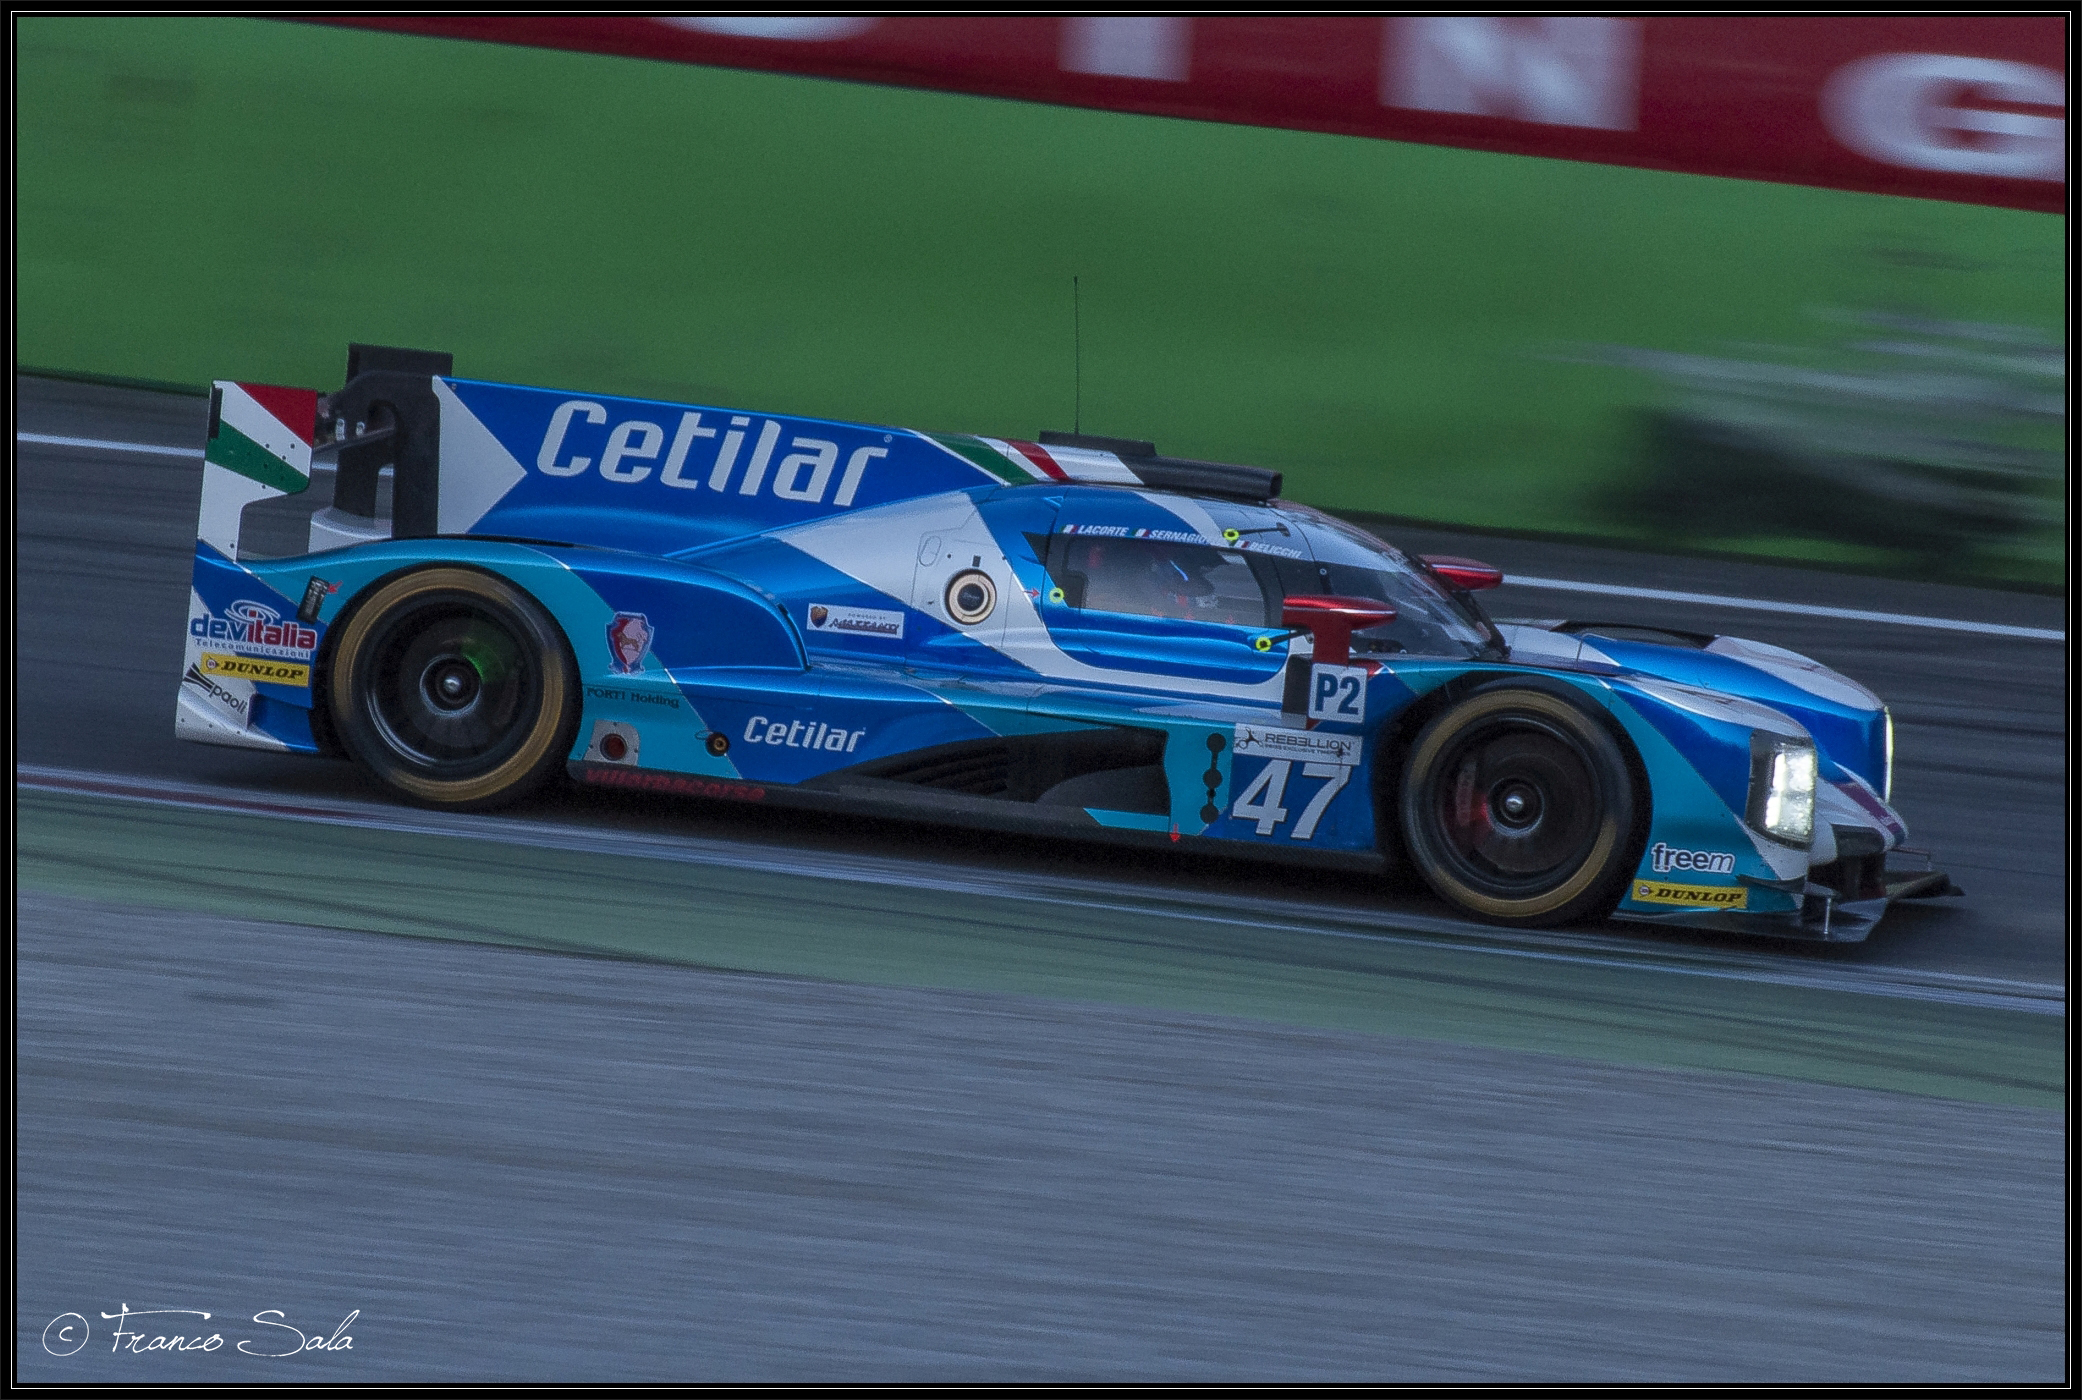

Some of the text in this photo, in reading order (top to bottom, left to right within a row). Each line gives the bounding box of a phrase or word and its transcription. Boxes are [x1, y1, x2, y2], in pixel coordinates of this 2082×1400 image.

[537, 400, 888, 507] Cetilar
[1078, 525, 1130, 537] LACORTE
[190, 611, 317, 650] devitalia
[195, 638, 311, 660] Telecomunicazioni
[221, 660, 304, 680] DUNLOP
[209, 684, 248, 715] paoli
[630, 692, 680, 709] Holding
[1314, 672, 1361, 715] P2
[743, 716, 864, 753] Cetilar
[1232, 758, 1352, 840] 47
[1653, 843, 1735, 873] freem
[1656, 887, 1742, 904] DUNLOP
